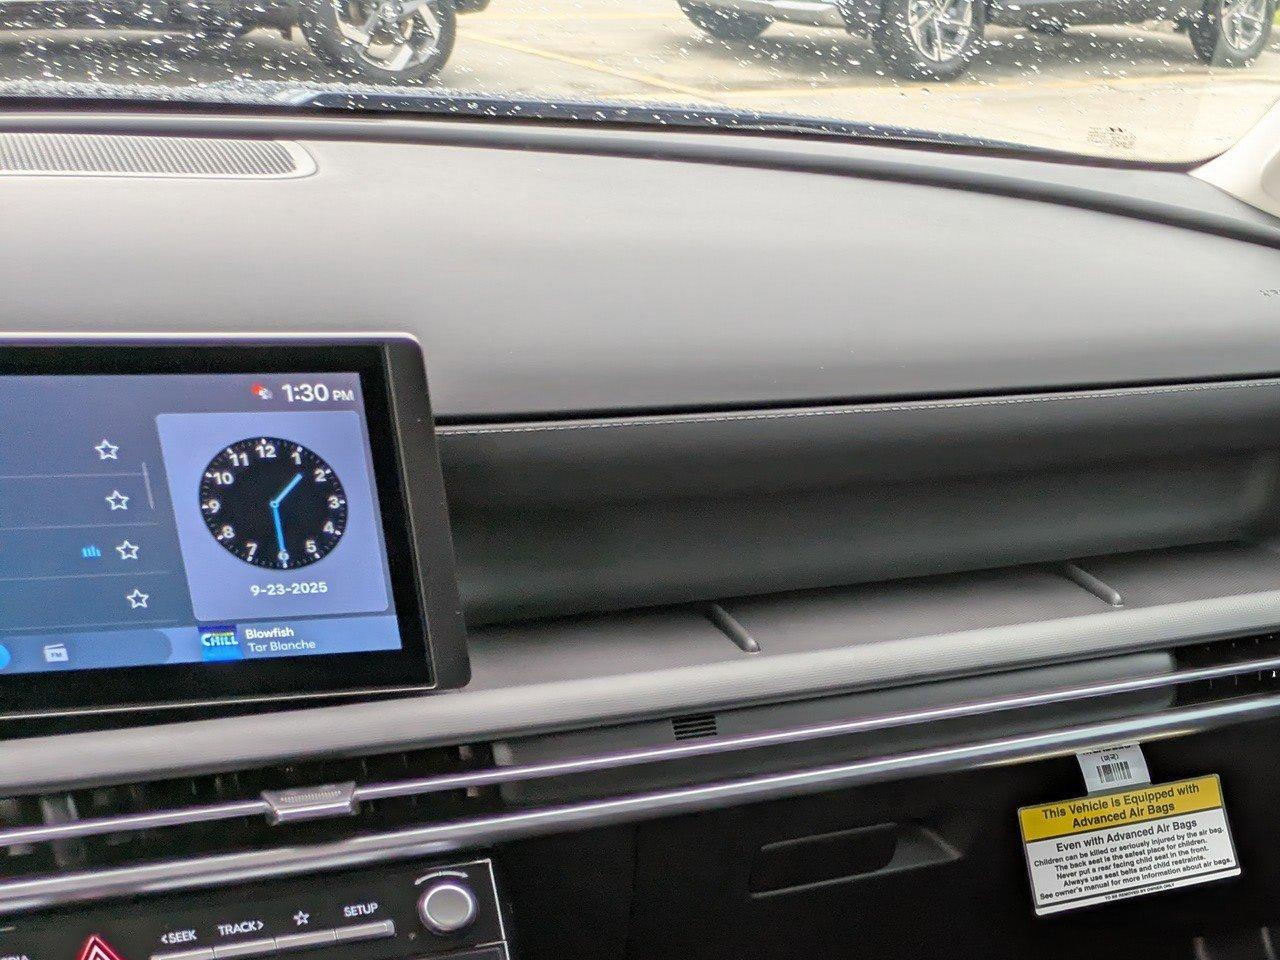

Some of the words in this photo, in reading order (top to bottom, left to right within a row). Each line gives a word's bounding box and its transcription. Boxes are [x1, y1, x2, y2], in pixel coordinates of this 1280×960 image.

[281, 383, 330, 403] 1:30
[332, 389, 356, 402] PM
[255, 444, 277, 459] 12
[291, 451, 302, 466] 1
[228, 452, 250, 467] 11
[213, 471, 235, 485] 10
[314, 468, 327, 482] 2
[208, 499, 221, 514] 9
[327, 495, 341, 510] 3
[221, 524, 235, 539] 8
[323, 520, 335, 534] 4
[246, 542, 258, 556] 7
[304, 539, 317, 554] 5
[249, 581, 329, 597] 9-23-2025
[200, 632, 239, 647] CHILL
[245, 626, 295, 640] Blowfish
[269, 638, 316, 652] Blanche
[1042, 807, 1067, 820] This
[1068, 799, 1109, 815] Vehicle
[1123, 787, 1175, 805] Equipped
[1177, 783, 1200, 796] with
[1073, 809, 1127, 829] Advanced
[1129, 806, 1145, 819] Air
[1147, 803, 1175, 815] Bags
[1056, 841, 1082, 853] Even
[1083, 834, 1104, 847] with
[1106, 826, 1155, 843] Advanced
[1156, 823, 1170, 835] Air
[1172, 819, 1198, 831] Bags
[1034, 856, 1064, 867] Children
[1065, 854, 1078, 862] can
[1079, 851, 1089, 859] be
[1089, 848, 1109, 857] killed
[1119, 840, 1150, 852] seriously
[1151, 835, 1175, 845] injured
[1176, 833, 1185, 842] by
[1186, 831, 1198, 839] the
[1208, 827, 1224, 835] bag.
[1055, 864, 1068, 872] The
[1069, 860, 1087, 869] back
[1088, 858, 1103, 866] seat
[1104, 855, 1110, 863] is
[1111, 853, 1123, 861] the
[1124, 849, 1146, 859] safest
[1147, 845, 1165, 855] place
[1177, 839, 1208, 849] children.
[1056, 872, 1077, 880] Never
[1078, 868, 1091, 877] put
[1113, 859, 1135, 870] facing
[1136, 856, 1153, 865] child
[1178, 849, 1190, 857] the
[1190, 845, 1209, 855] front.
[1055, 886, 1083, 898] owner's
[1084, 881, 1110, 891] manual
[1111, 879, 1121, 887] for
[1122, 876, 1141, 884] more
[1142, 868, 1182, 880] information
[1182, 863, 1202, 872] about
[1203, 860, 1212, 868] air
[1213, 857, 1233, 866] bags.
[1063, 877, 1089, 888] Always
[1090, 874, 1103, 882] use
[1104, 871, 1119, 879] seat
[1120, 866, 1138, 876] belts
[1138, 864, 1152, 872] and
[1153, 861, 1171, 870] child
[343, 902, 379, 919] SETUP
[168, 929, 198, 944] SEEK
[217, 920, 257, 936] TRACK
